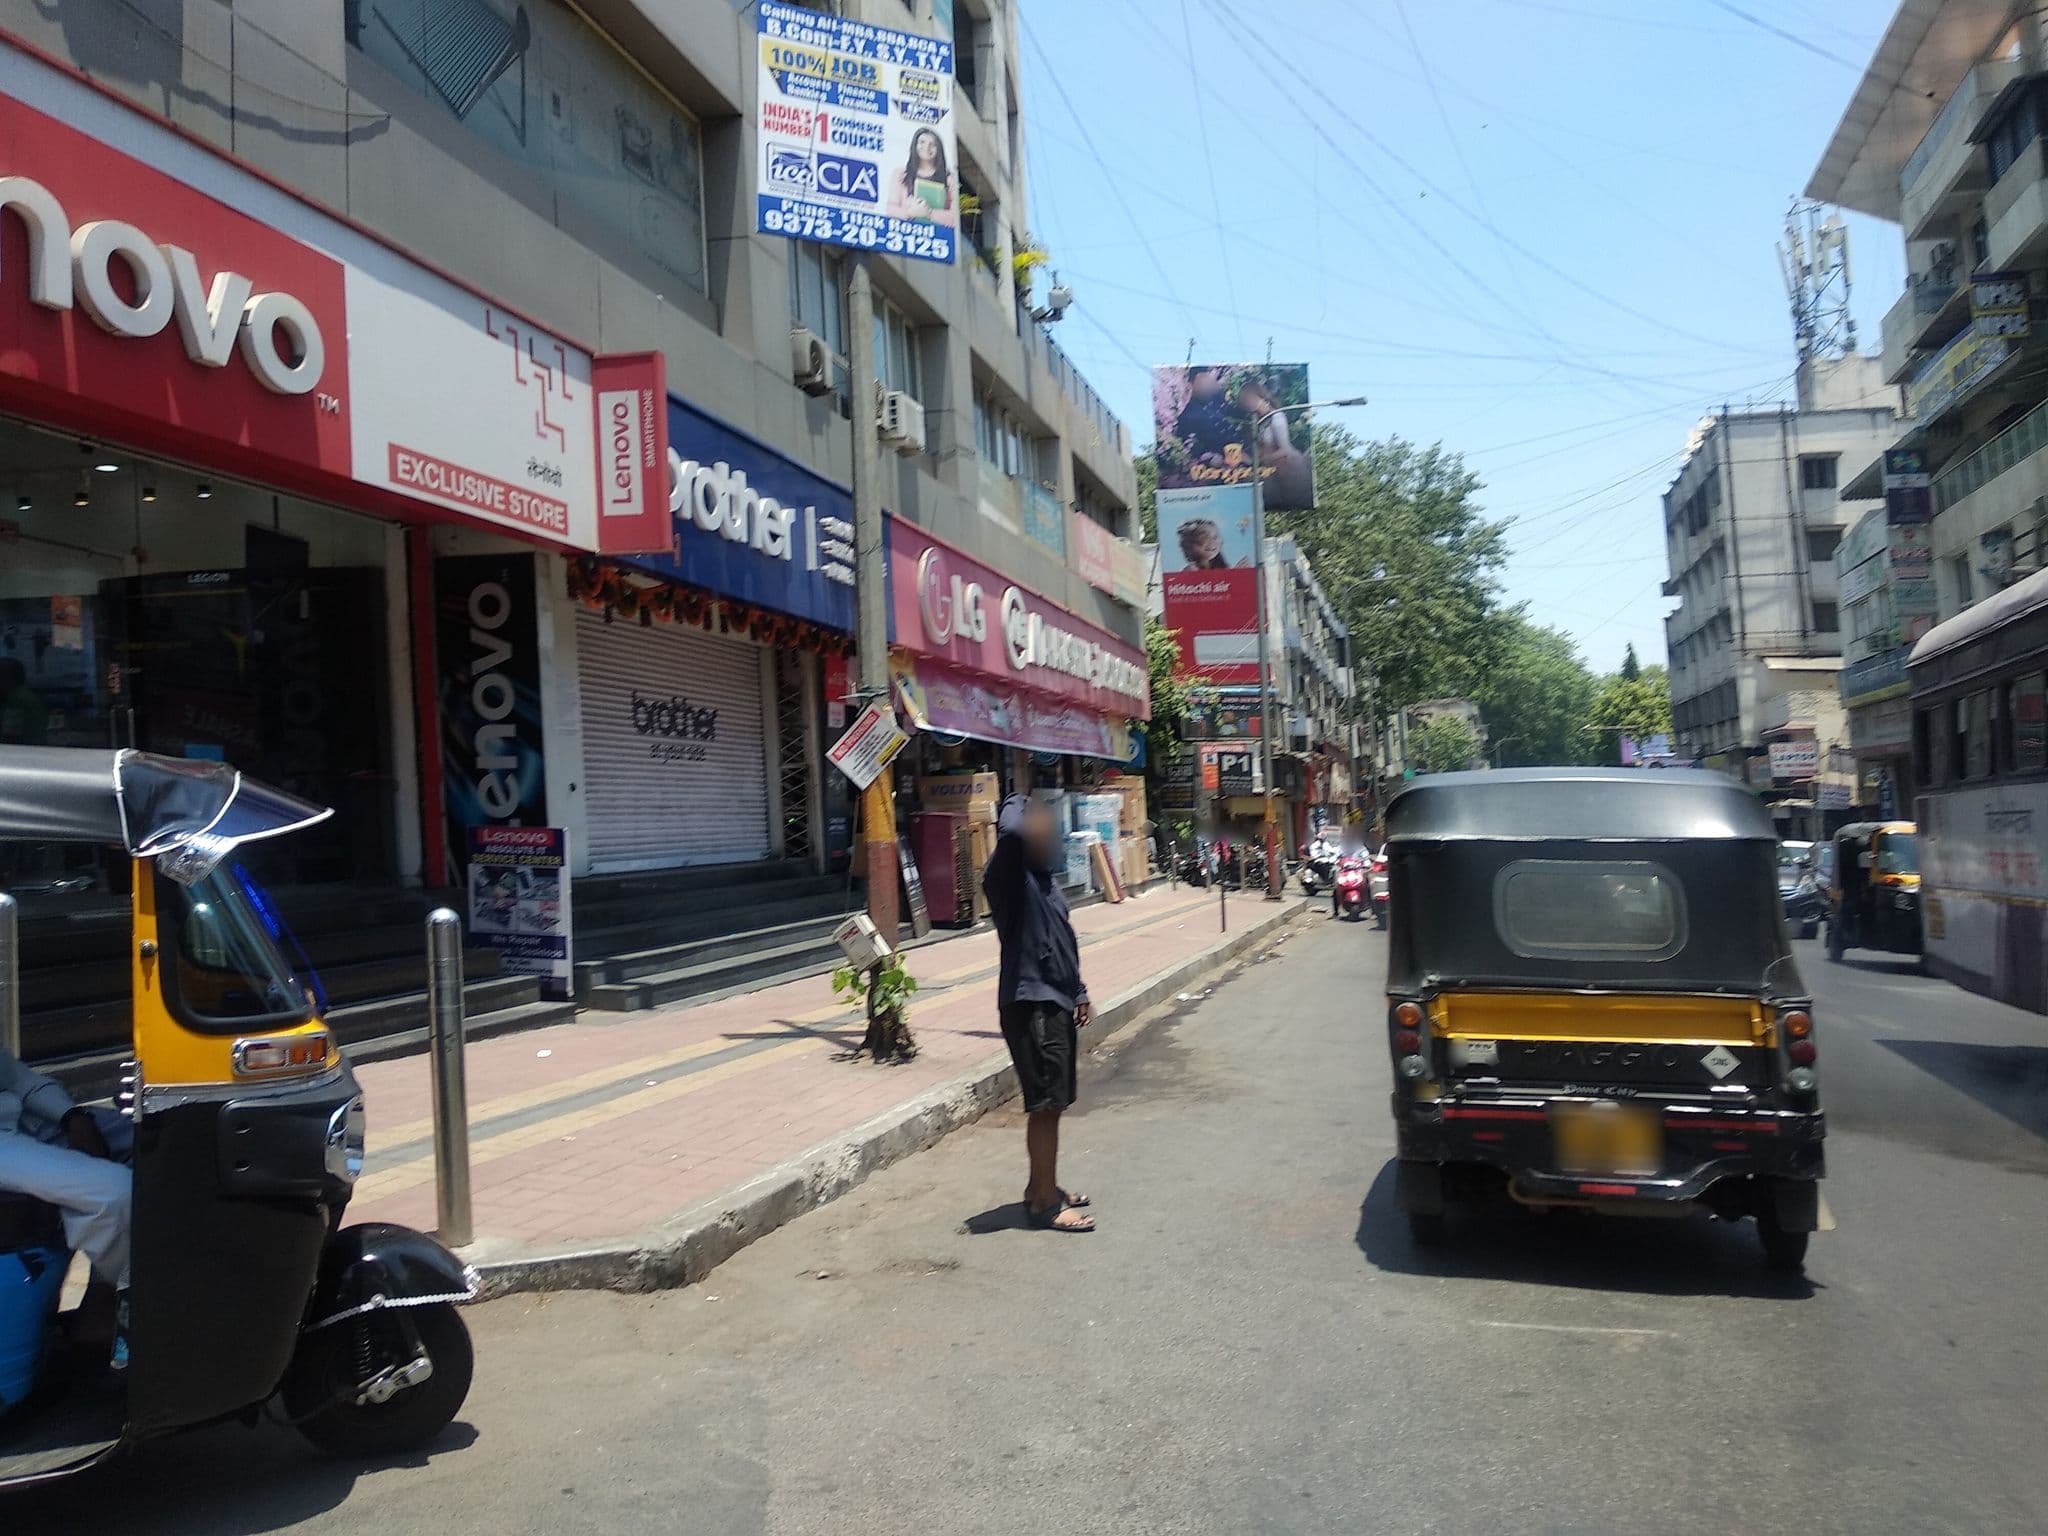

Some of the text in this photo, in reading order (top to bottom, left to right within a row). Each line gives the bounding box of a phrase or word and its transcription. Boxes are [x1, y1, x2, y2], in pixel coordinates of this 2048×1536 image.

[772, 48, 876, 80] 100% JOB
[763, 102, 812, 123] INDIA'S
[764, 112, 829, 142] NUMBER 1
[831, 116, 884, 133] COMMERCE
[832, 130, 884, 152] COURSE
[764, 210, 950, 260] 9373-20-3125
[839, 210, 886, 230] Tilak
[888, 218, 935, 238] Road
[644, 389, 656, 468] SMARTPHONE
[611, 400, 632, 506] Lenovo
[396, 453, 566, 530] EXCLUSIVE STORE
[1167, 581, 1211, 596] Hitachi
[951, 575, 988, 643] LG
[467, 582, 521, 828] enovo
[632, 689, 718, 743] brother
[929, 783, 984, 796] VOLTAS
[482, 829, 548, 844] Lenovo
[471, 854, 562, 866] SERVICE CENTER
